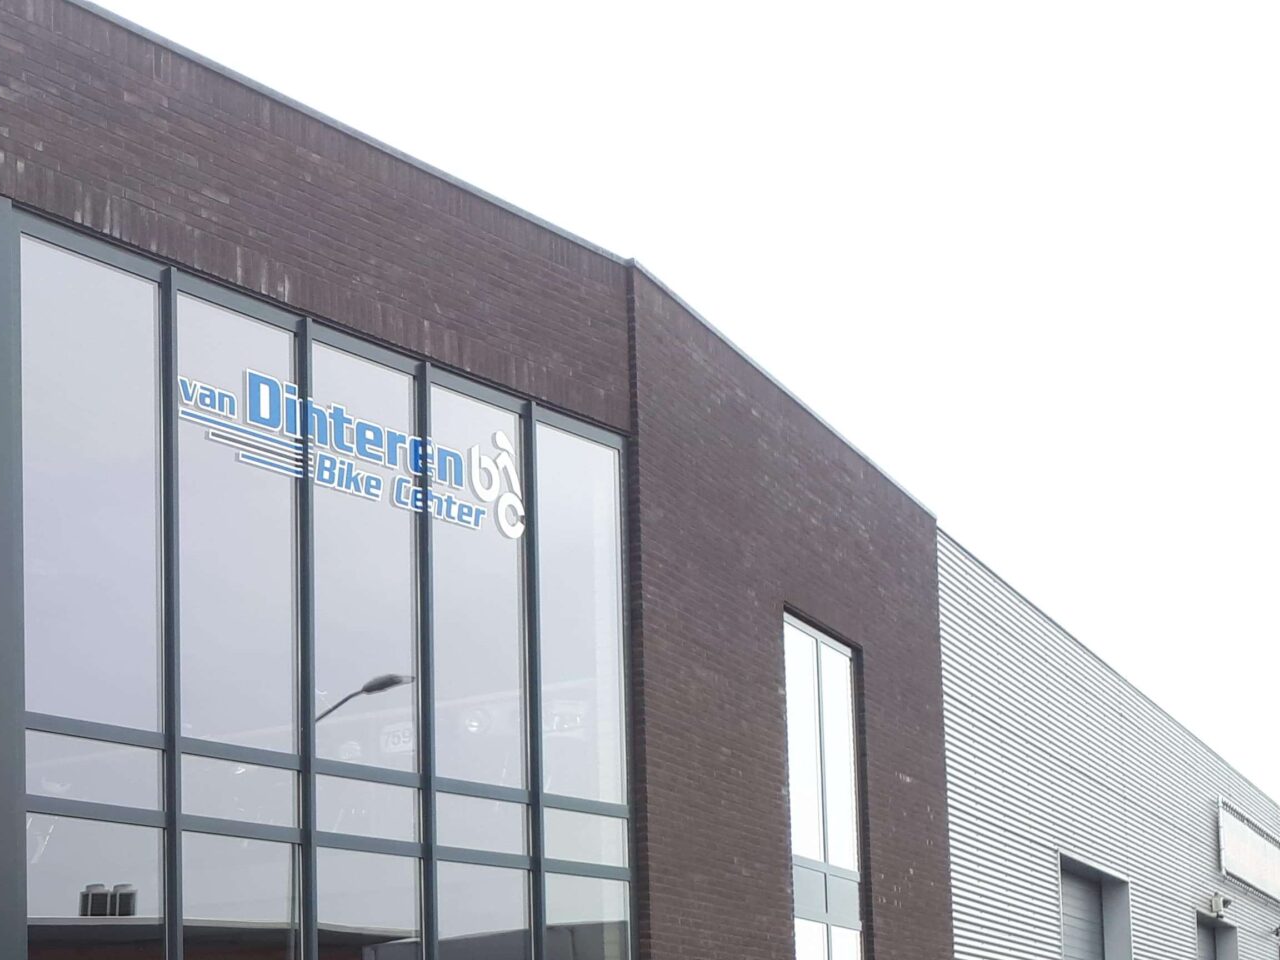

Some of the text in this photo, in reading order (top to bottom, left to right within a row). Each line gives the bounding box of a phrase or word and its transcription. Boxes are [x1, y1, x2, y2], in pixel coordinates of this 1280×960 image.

[178, 368, 464, 489] van Dinteren
[315, 451, 486, 530] Bike Center
